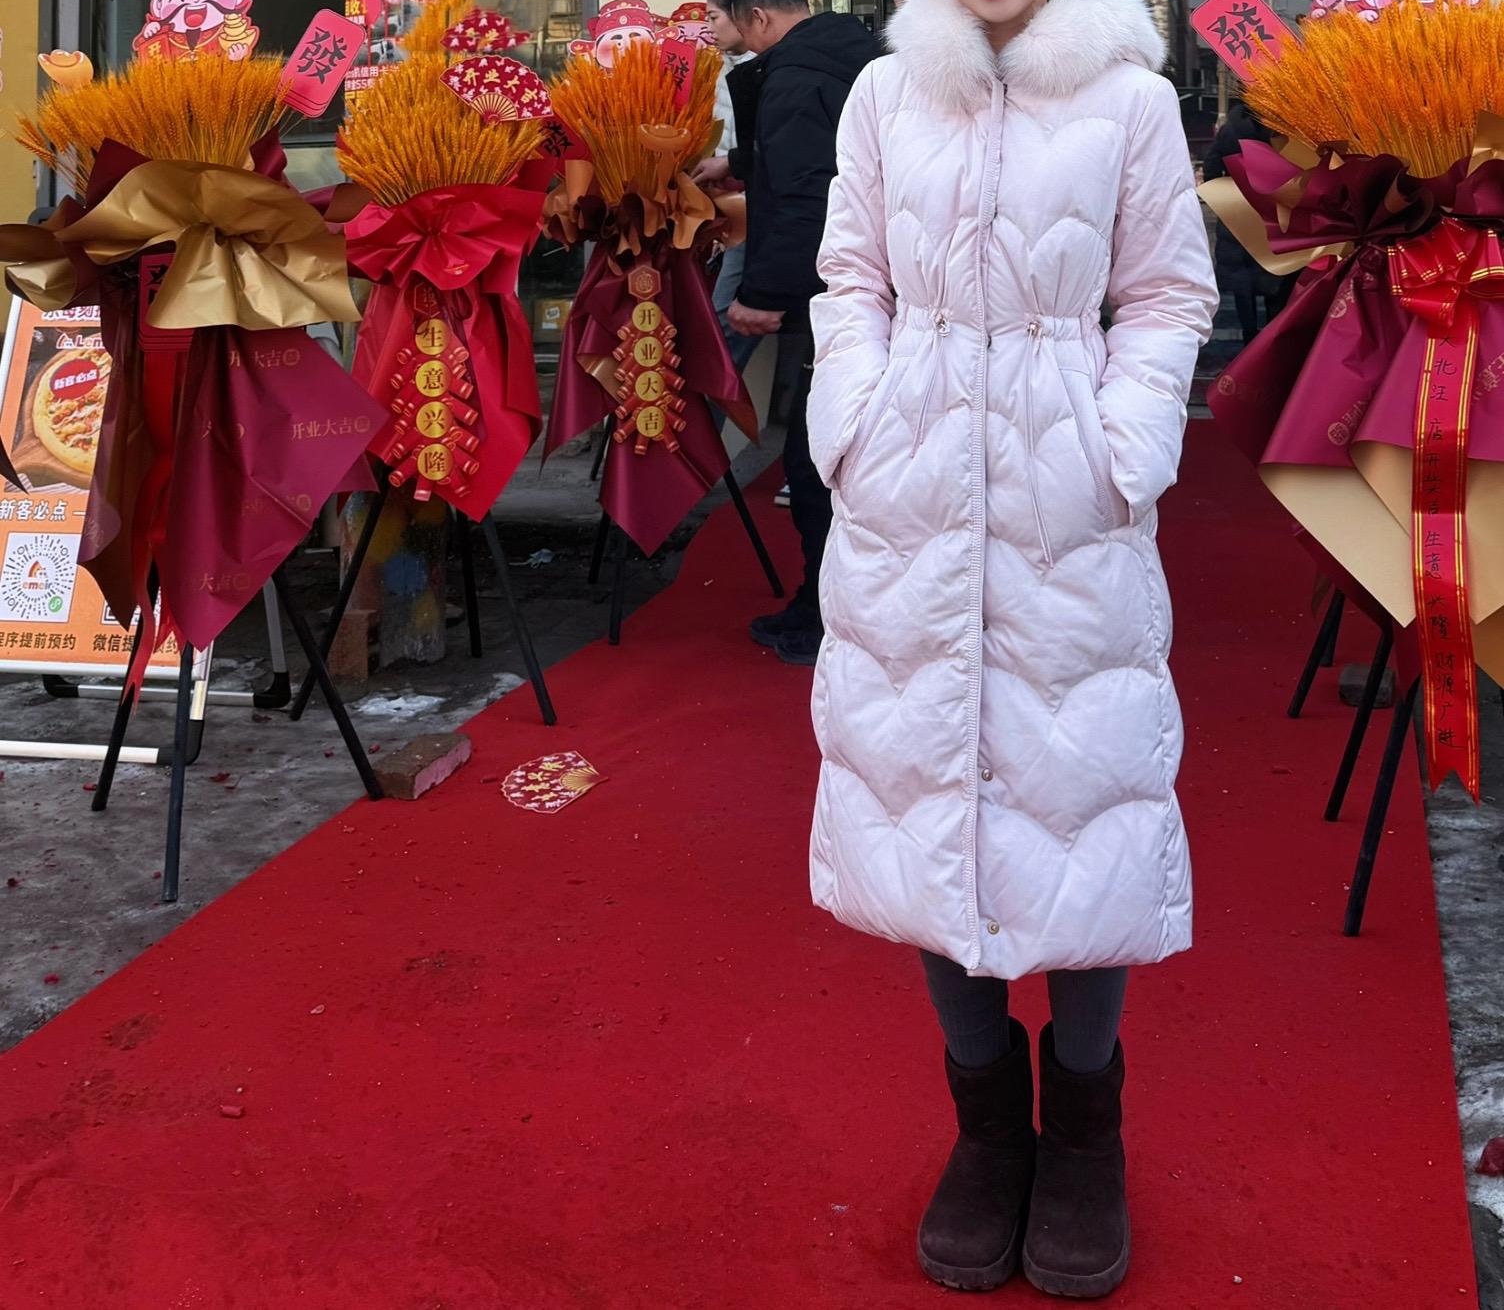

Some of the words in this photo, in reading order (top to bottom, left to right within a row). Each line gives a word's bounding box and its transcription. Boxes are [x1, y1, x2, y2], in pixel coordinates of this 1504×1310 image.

[299, 26, 349, 85] 發
[462, 68, 538, 104] 开业大吉
[639, 307, 660, 432] 开业大吉
[421, 326, 447, 475] 生意兴隆
[292, 418, 352, 440] 开业大吉
[0, 499, 67, 521] 新客必点
